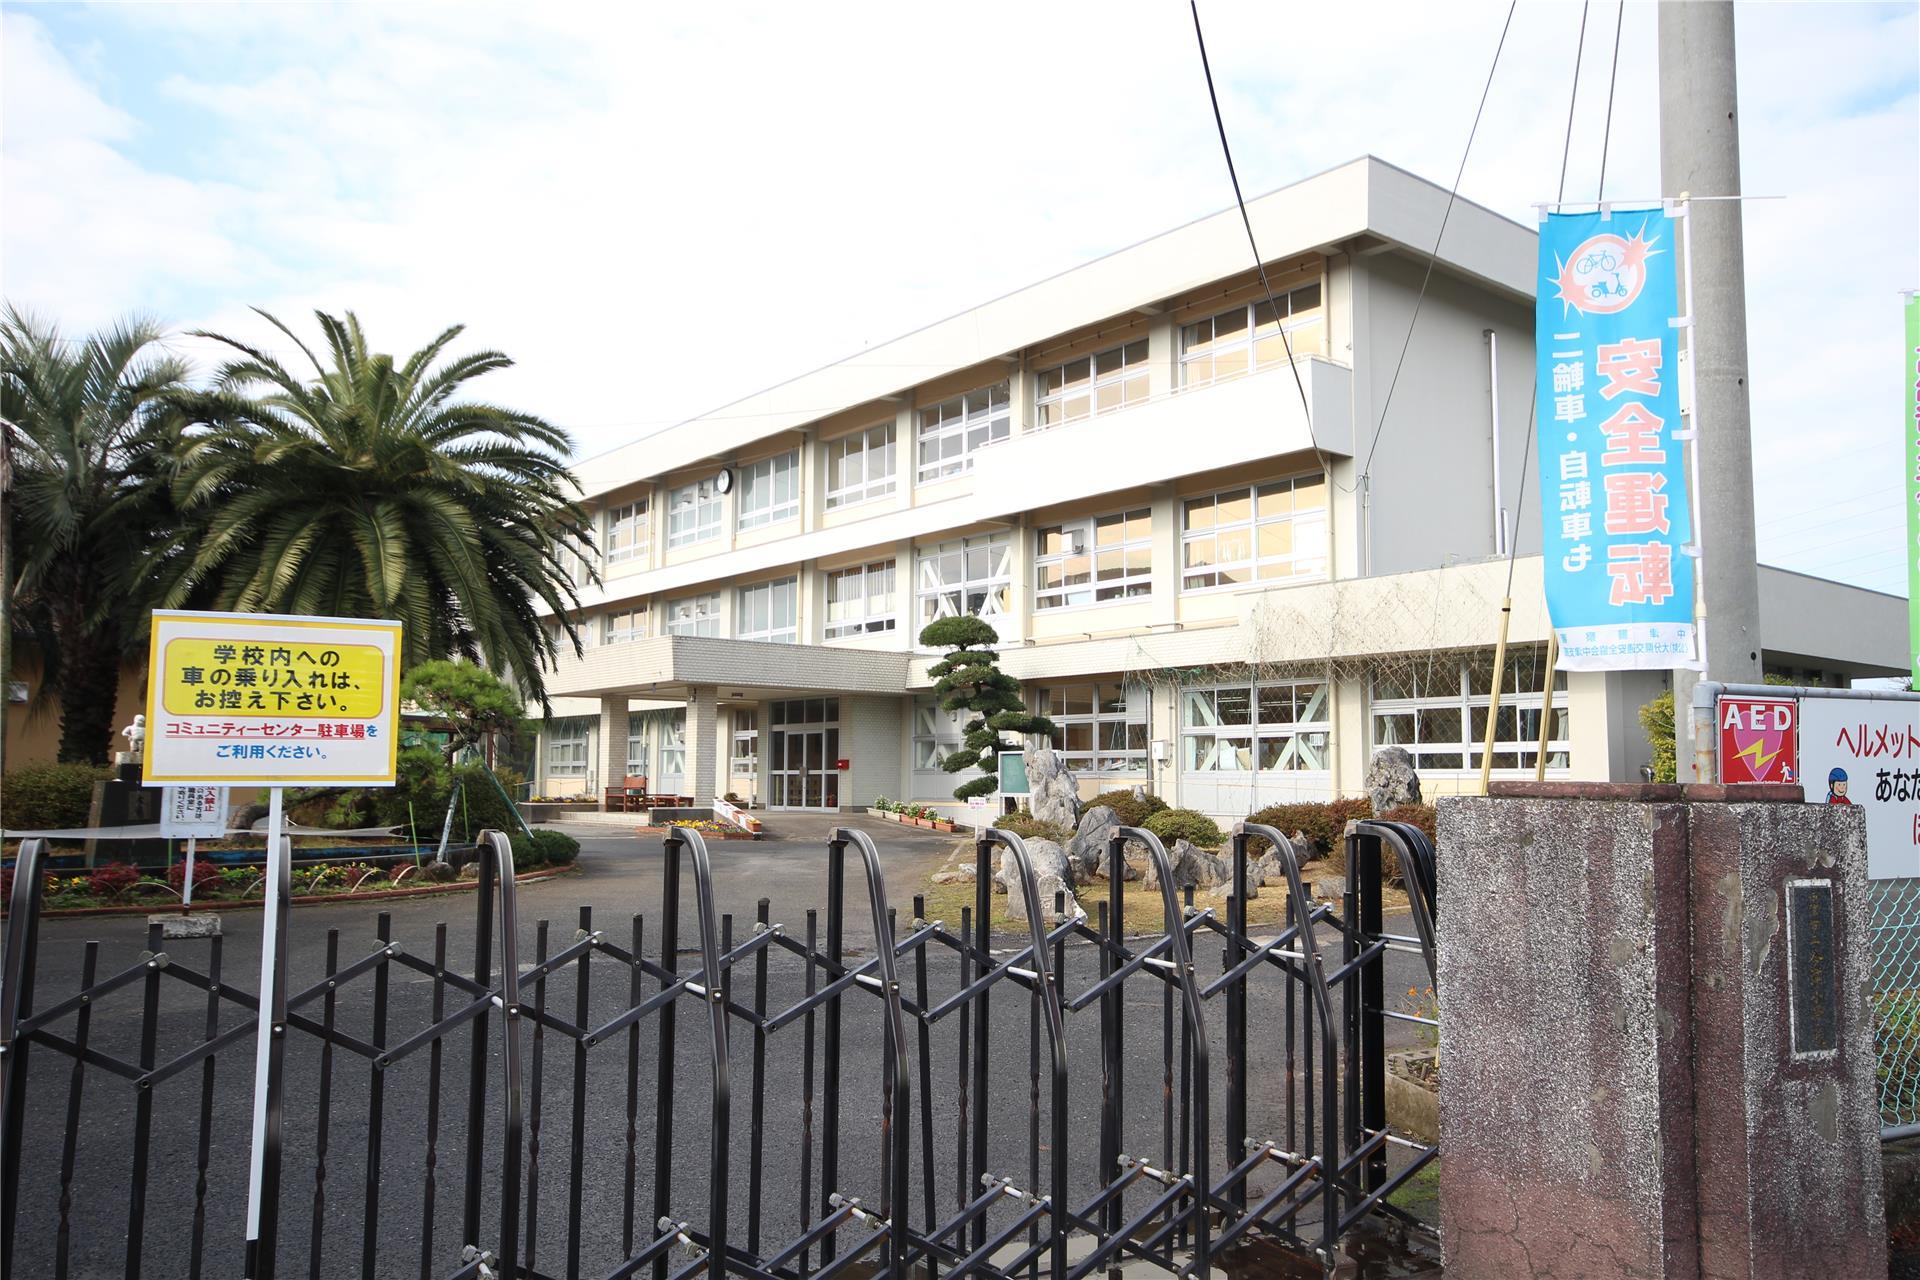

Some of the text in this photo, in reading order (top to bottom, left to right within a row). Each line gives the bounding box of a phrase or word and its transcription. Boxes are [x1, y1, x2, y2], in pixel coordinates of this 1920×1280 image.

[214, 645, 340, 667] 学校内への
[181, 666, 361, 690] 車の乗り入れは、
[194, 689, 350, 712] お控え下さい。
[1723, 704, 1792, 731] AED
[166, 721, 378, 738] コミュニティーセンター駐車場を
[1836, 723, 1920, 759] ヘルメット
[216, 744, 328, 760] ご利用ください。
